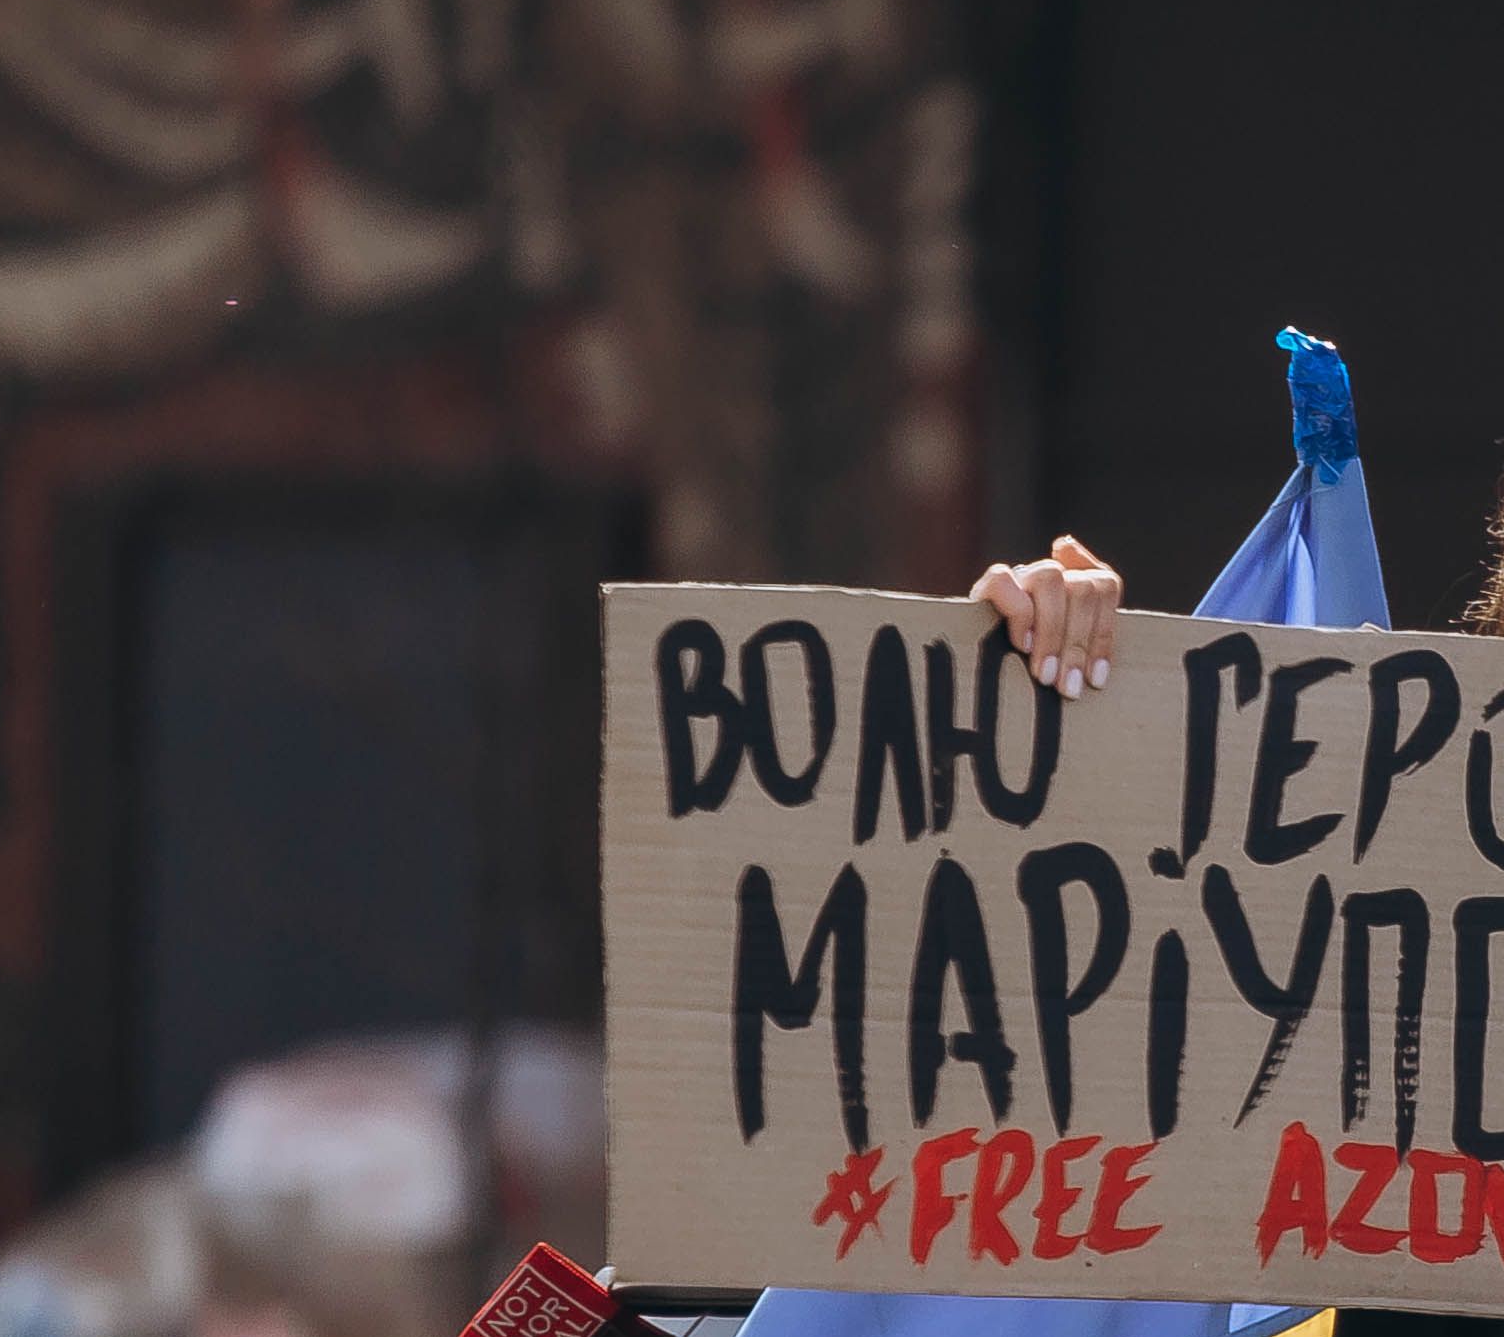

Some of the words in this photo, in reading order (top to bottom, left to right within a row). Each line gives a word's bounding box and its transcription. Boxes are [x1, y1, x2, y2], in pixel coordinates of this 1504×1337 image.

[656, 619, 1063, 844] ВОЛЮ
[812, 1126, 1164, 1267] #FREE
[486, 1277, 542, 1337] NOT
